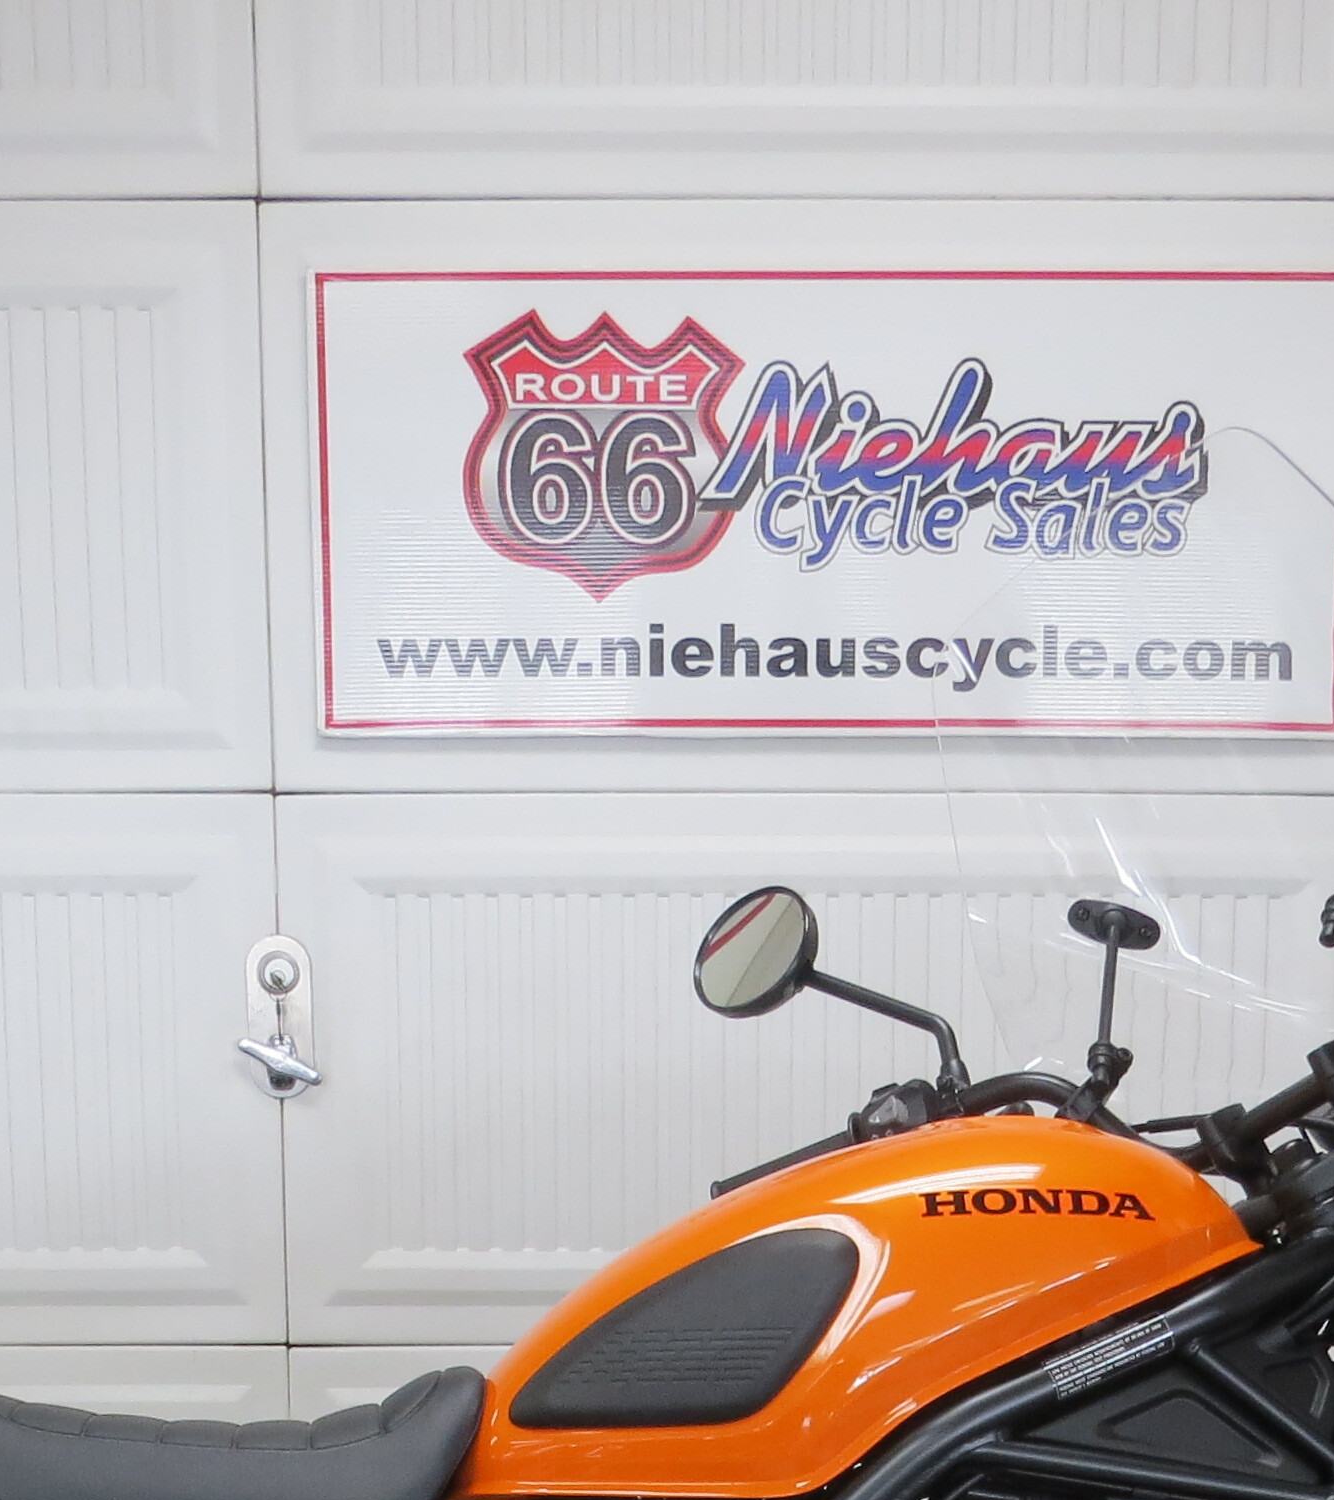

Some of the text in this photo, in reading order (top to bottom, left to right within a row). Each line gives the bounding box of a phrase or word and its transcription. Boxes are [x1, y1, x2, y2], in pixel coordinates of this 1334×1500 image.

[515, 371, 688, 405] ROUTE
[701, 358, 1208, 510] Niehaus
[499, 411, 697, 547] 66
[755, 476, 1190, 571] Cycle Sales
[377, 625, 1293, 692] www.niehauscycle.com
[919, 1189, 1155, 1220] HONDA
